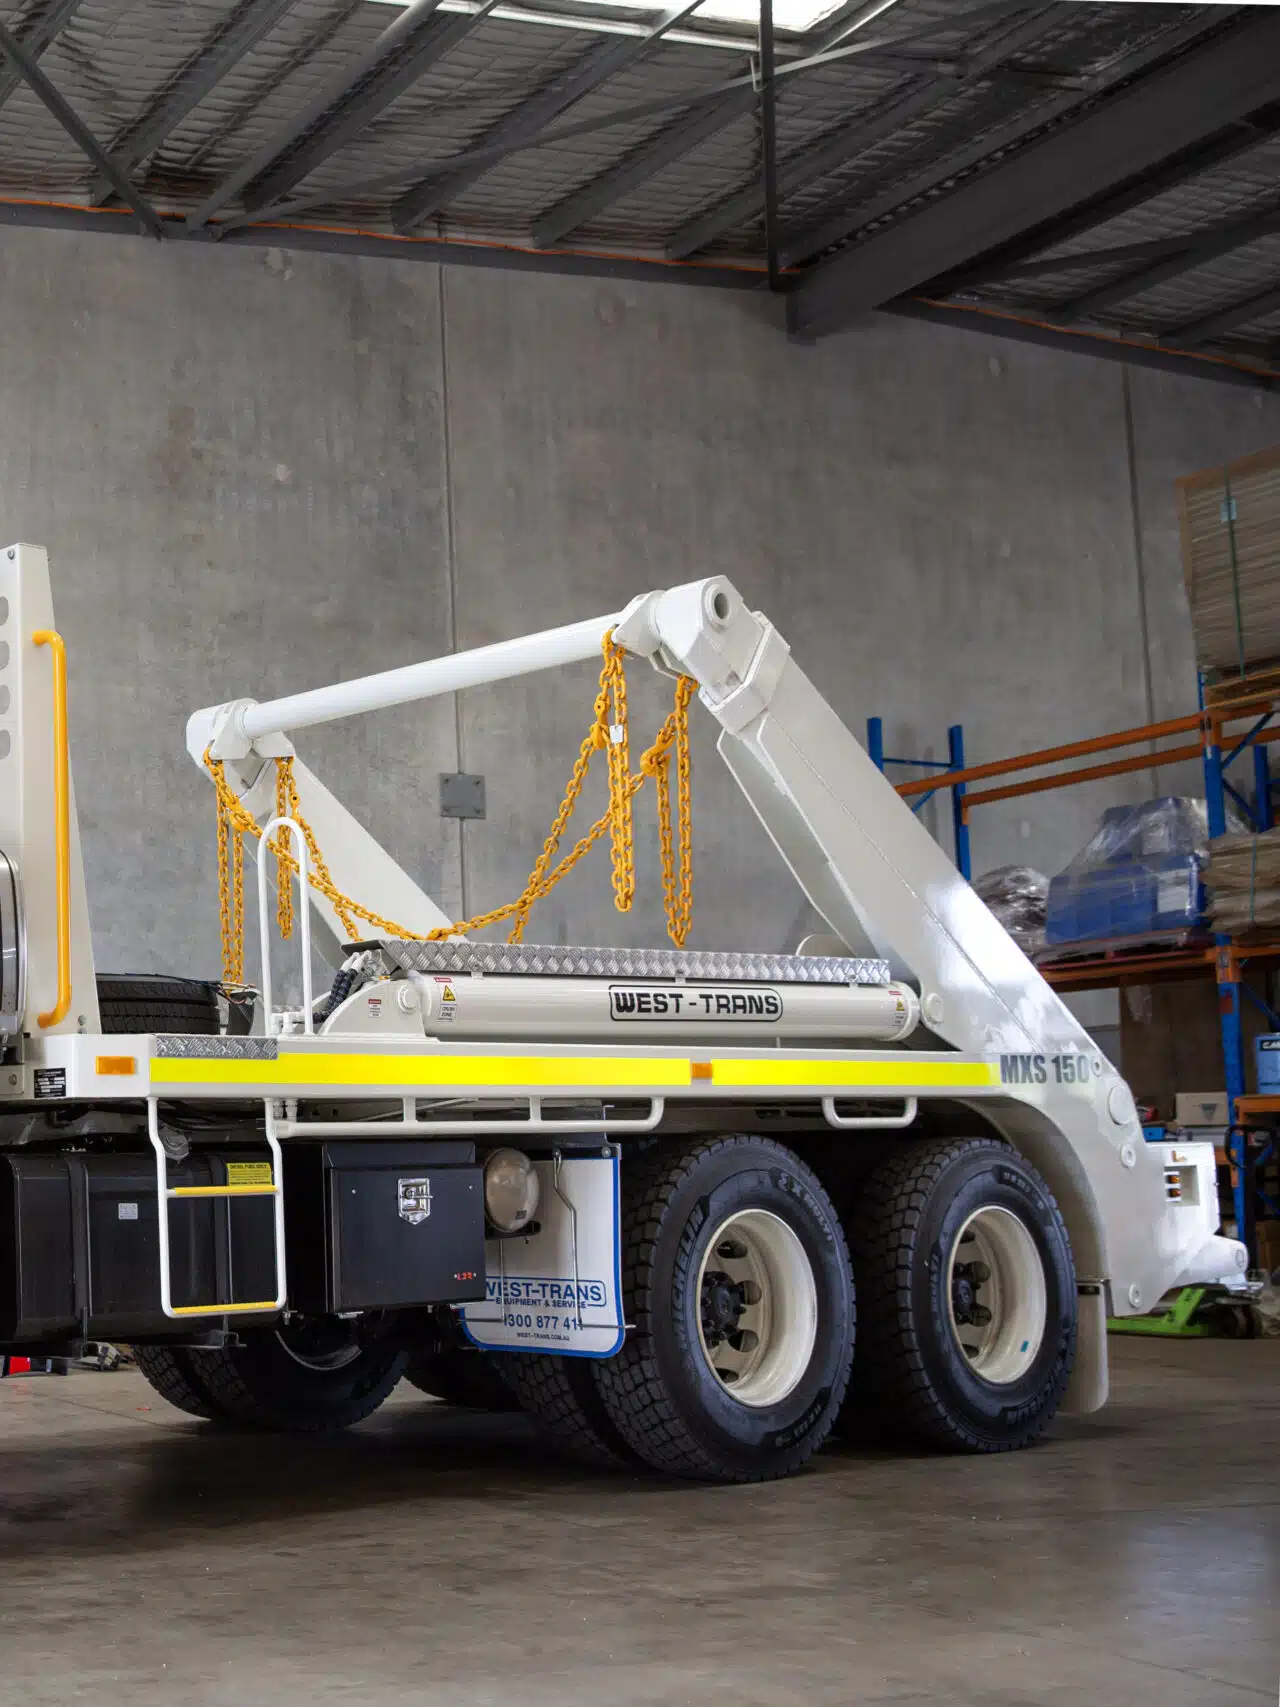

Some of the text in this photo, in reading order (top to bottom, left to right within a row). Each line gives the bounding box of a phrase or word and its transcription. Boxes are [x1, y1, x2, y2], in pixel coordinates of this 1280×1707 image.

[1000, 1055, 1089, 1084] MXS 150
[552, 1299, 587, 1309] SERVIE
[536, 1315, 559, 1330] 877
